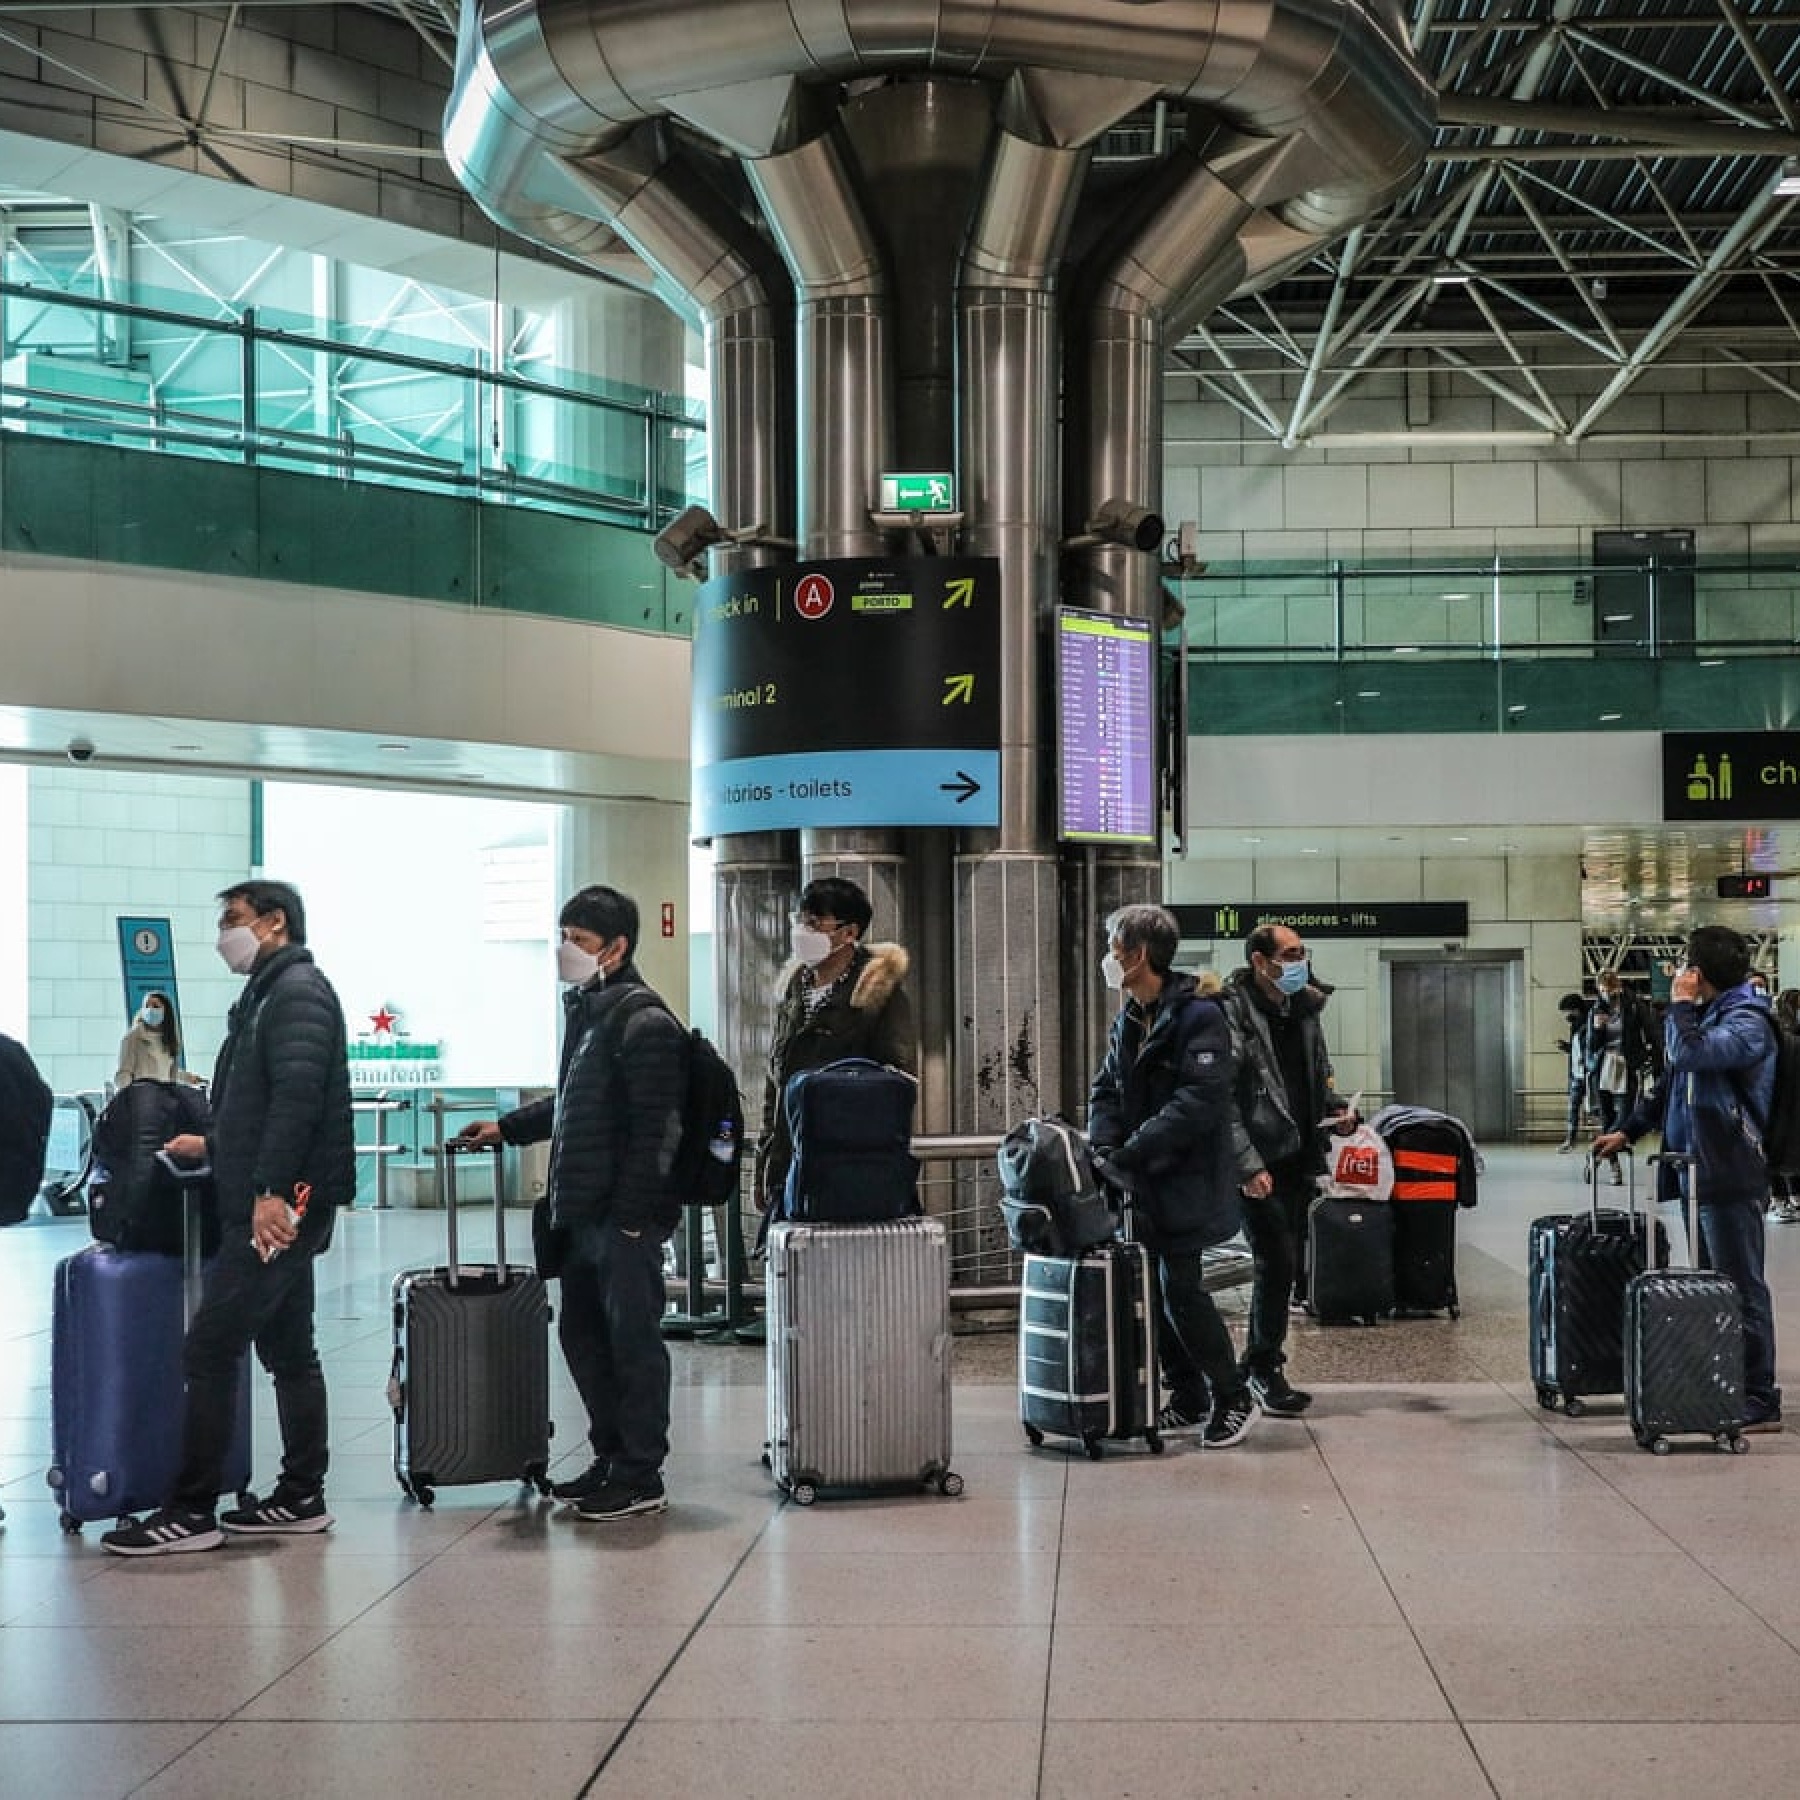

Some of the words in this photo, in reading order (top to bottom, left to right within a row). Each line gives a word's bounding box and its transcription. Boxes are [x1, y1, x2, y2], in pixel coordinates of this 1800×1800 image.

[744, 593, 759, 614] in
[804, 583, 823, 609] A
[765, 683, 777, 704] 2
[1761, 759, 1798, 785] ch
[788, 777, 852, 800] toilets
[1351, 911, 1377, 926] lifts
[347, 1039, 439, 1060] eineken
